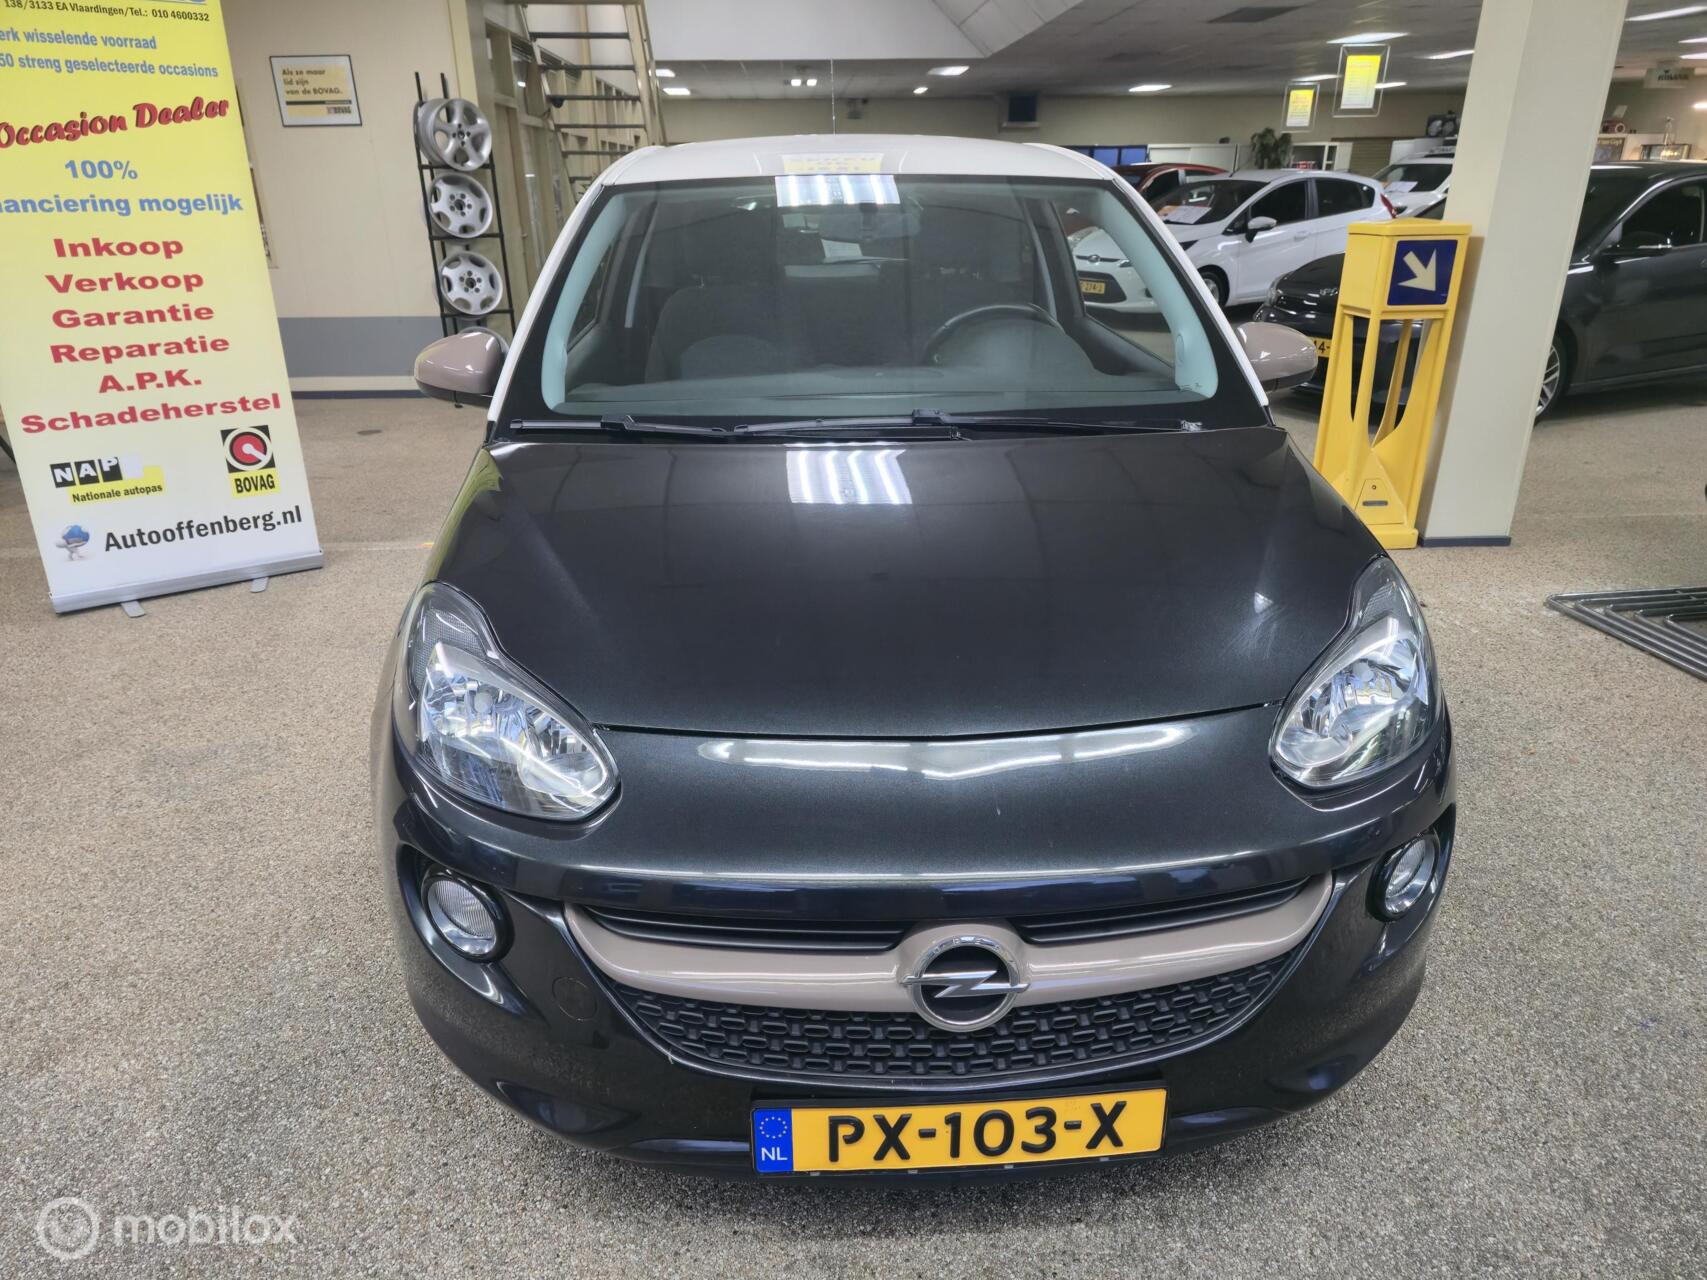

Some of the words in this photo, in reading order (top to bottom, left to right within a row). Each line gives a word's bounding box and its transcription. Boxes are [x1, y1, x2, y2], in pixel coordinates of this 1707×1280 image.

[56, 1, 69, 11] EA
[152, 8, 168, 19] 010
[171, 10, 210, 22] 4600332
[23, 28, 98, 46] wisselende
[101, 35, 157, 49] voorraad
[19, 54, 62, 73] streng
[65, 58, 155, 74] geselecteerde
[159, 63, 219, 77] occasions
[0, 111, 128, 149] Occasion
[132, 96, 229, 129] Dealer
[65, 159, 139, 180] 100%
[0, 194, 132, 217] anciering
[139, 193, 244, 215] mogelijk
[53, 238, 184, 259] Inkoop
[45, 272, 204, 294] Verkoop
[52, 303, 214, 329] Garantie
[50, 336, 230, 364] Reparatie
[99, 369, 202, 393] A.P.K.
[21, 393, 281, 434] Schadeherstel
[53, 456, 119, 483] NAP
[72, 487, 122, 503] Nationale
[124, 483, 163, 496] autopas
[235, 473, 275, 494] BOVAG
[104, 505, 303, 551] Autooffenberg.nl
[828, 1100, 1127, 1163] PX-103-X
[761, 1146, 788, 1162] NL
